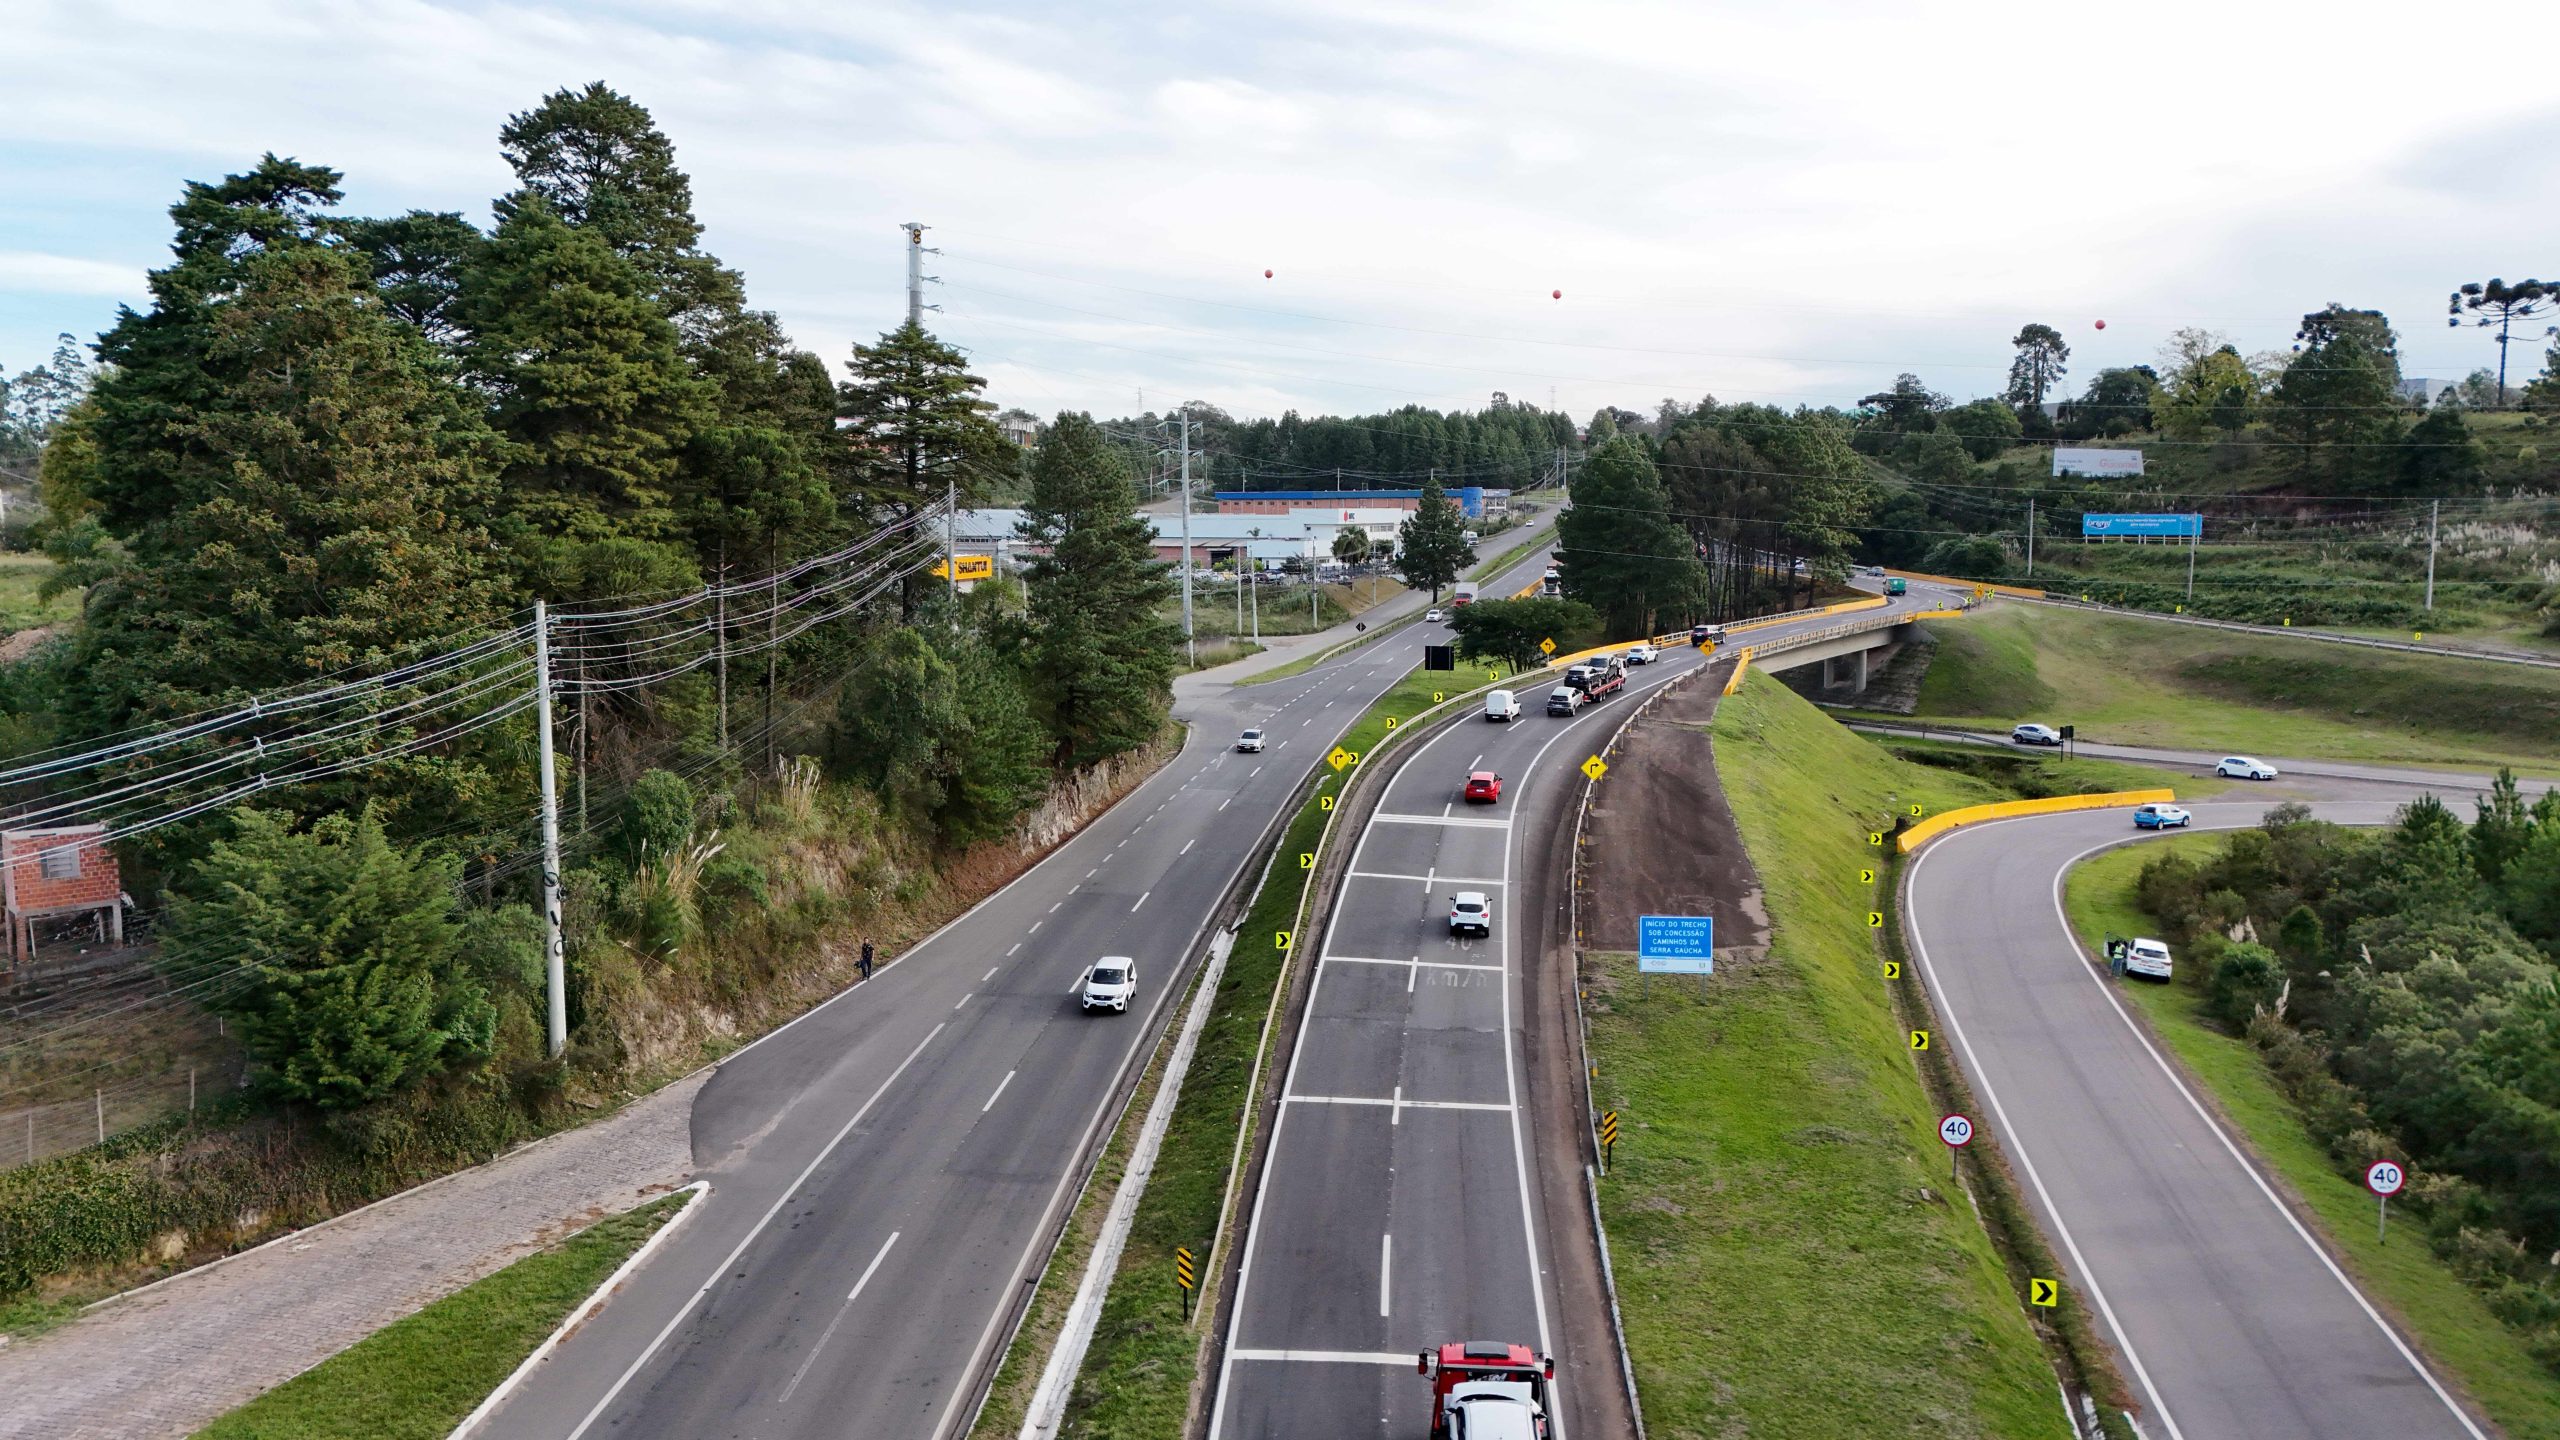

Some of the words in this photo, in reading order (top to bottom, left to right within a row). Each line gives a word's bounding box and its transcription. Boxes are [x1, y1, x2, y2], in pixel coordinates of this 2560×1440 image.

[1645, 920, 1666, 928] INÍCIO
[1664, 929, 1705, 937] CONCESSÃO
[1674, 946, 1703, 954] GAÚCHA
[1945, 1121, 1968, 1136] 40
[2374, 1168, 2398, 1183] 40
